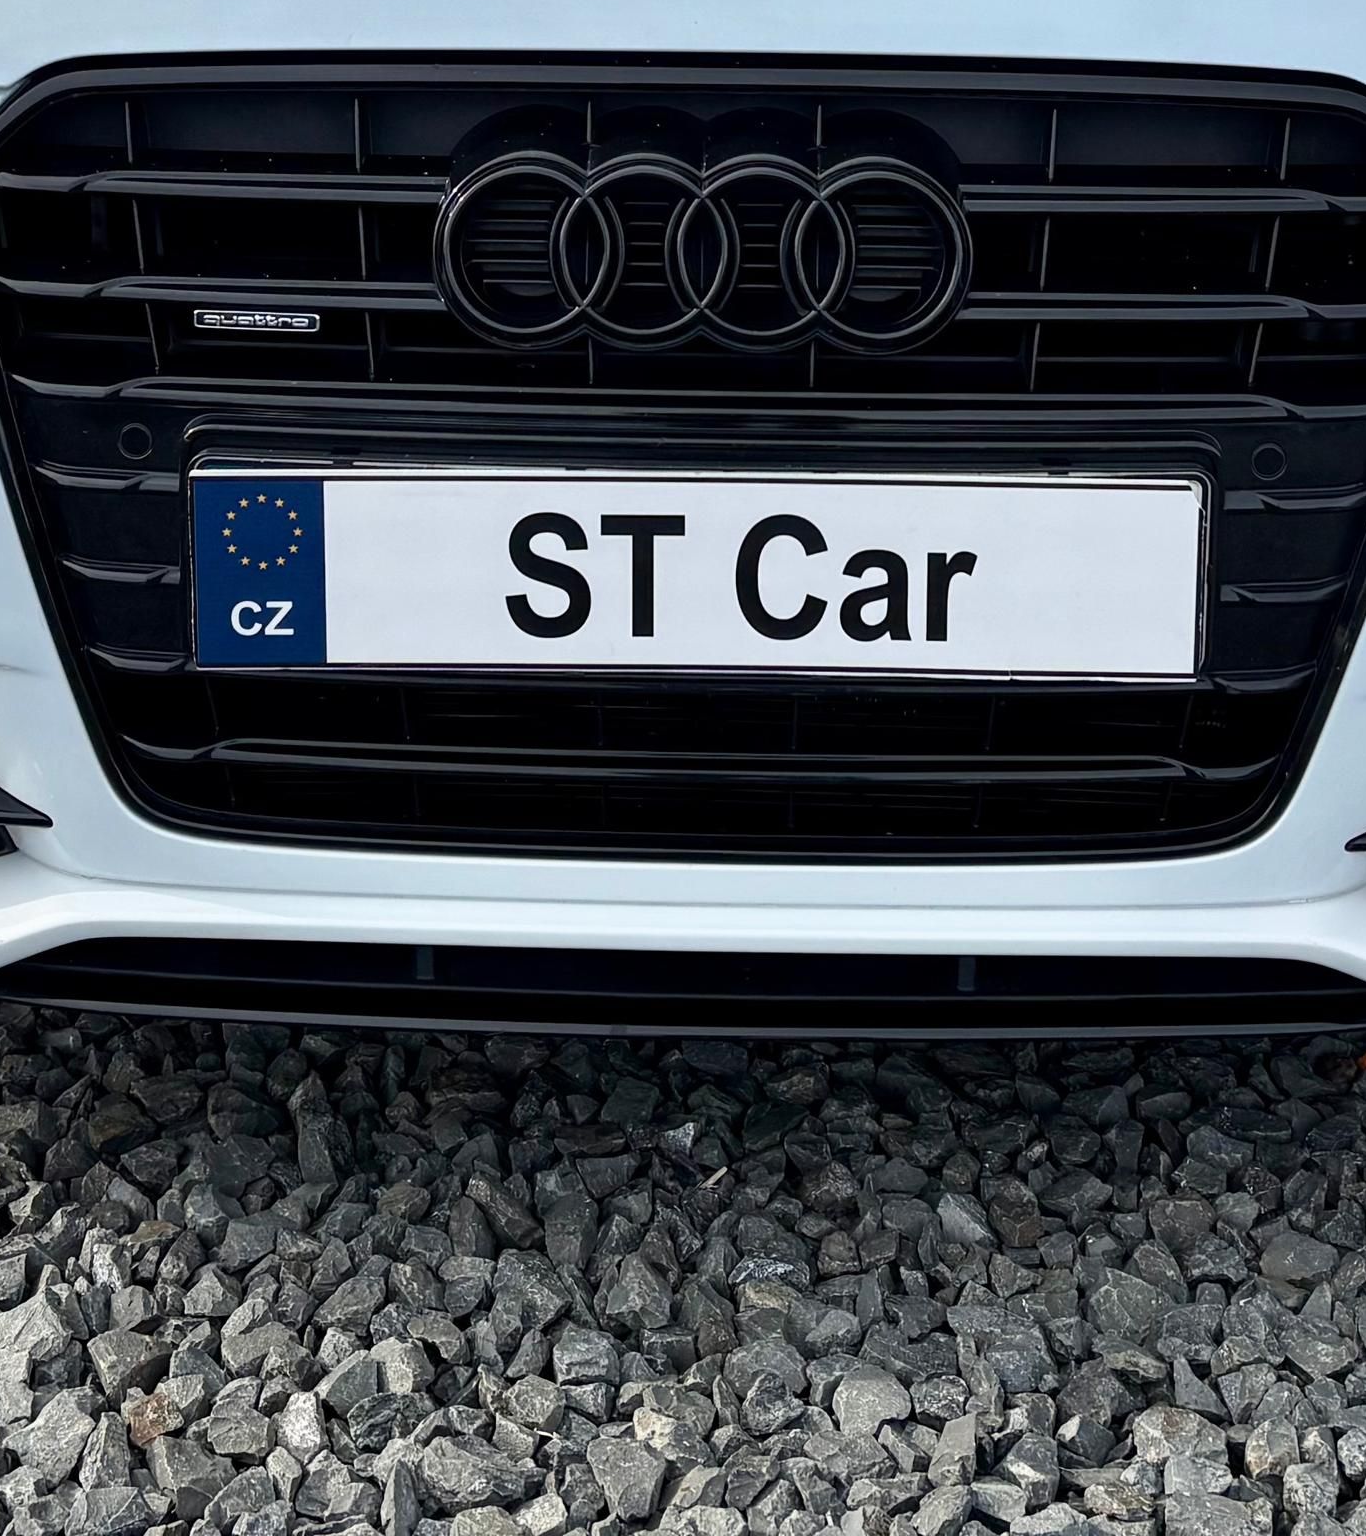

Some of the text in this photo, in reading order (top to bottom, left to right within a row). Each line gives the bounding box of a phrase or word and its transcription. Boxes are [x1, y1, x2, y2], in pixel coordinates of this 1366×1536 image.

[203, 314, 309, 327] quattro
[506, 513, 977, 641] ST Car
[231, 601, 294, 635] CZ
